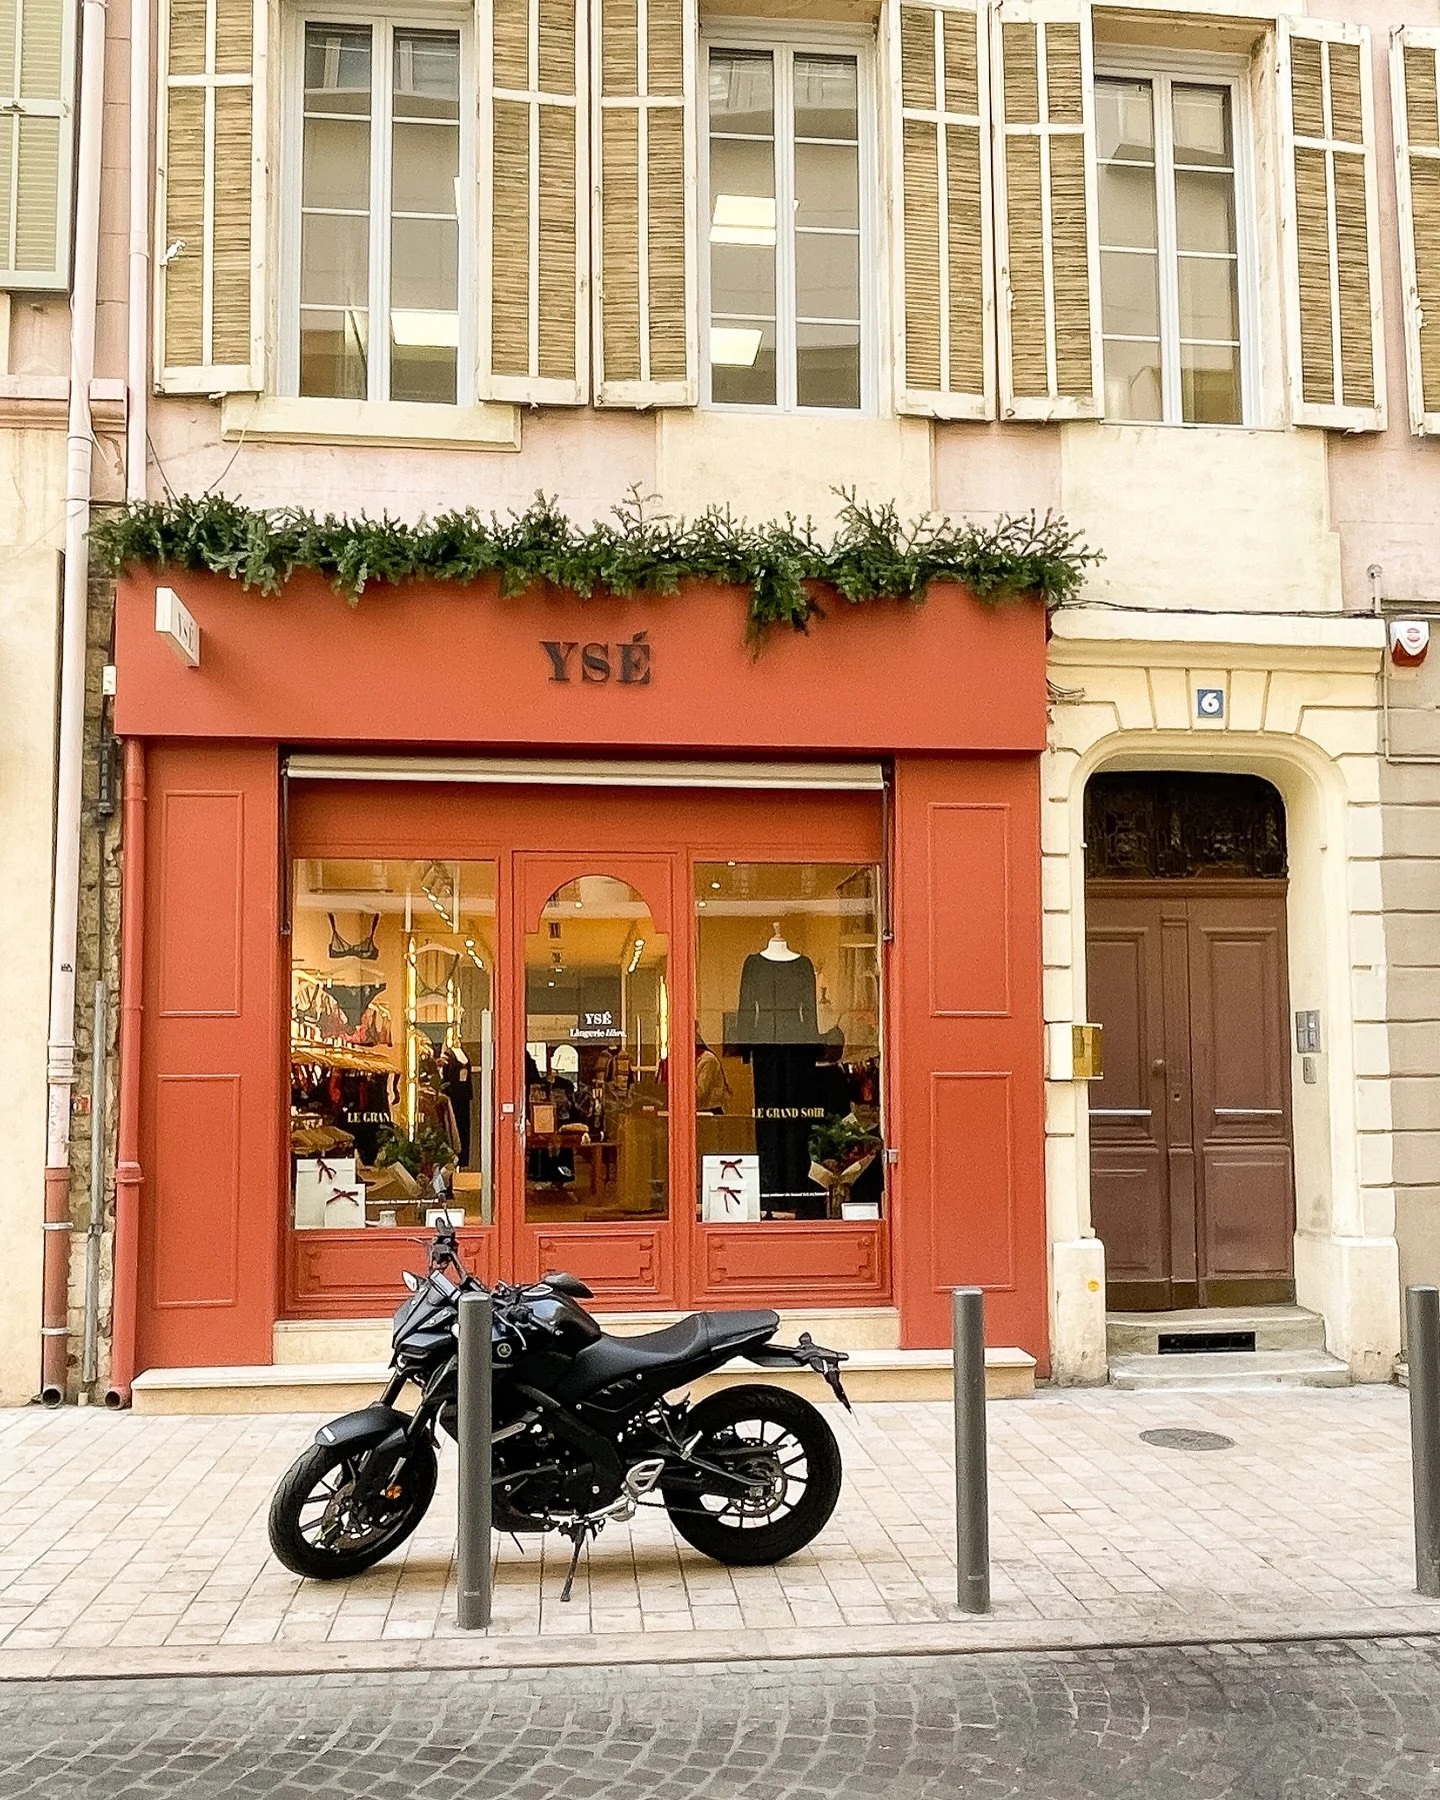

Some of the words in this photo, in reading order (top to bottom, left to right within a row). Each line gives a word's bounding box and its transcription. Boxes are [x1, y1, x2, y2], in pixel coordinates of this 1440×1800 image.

[538, 630, 651, 685] YSÉ
[1201, 692, 1220, 714] 6
[584, 1010, 612, 1025] YSÉ
[347, 1111, 361, 1123] LE
[362, 1111, 398, 1123] GRAN
[751, 1107, 764, 1118] LE
[765, 1107, 799, 1118] GRAND
[800, 1107, 825, 1118] SOIR
